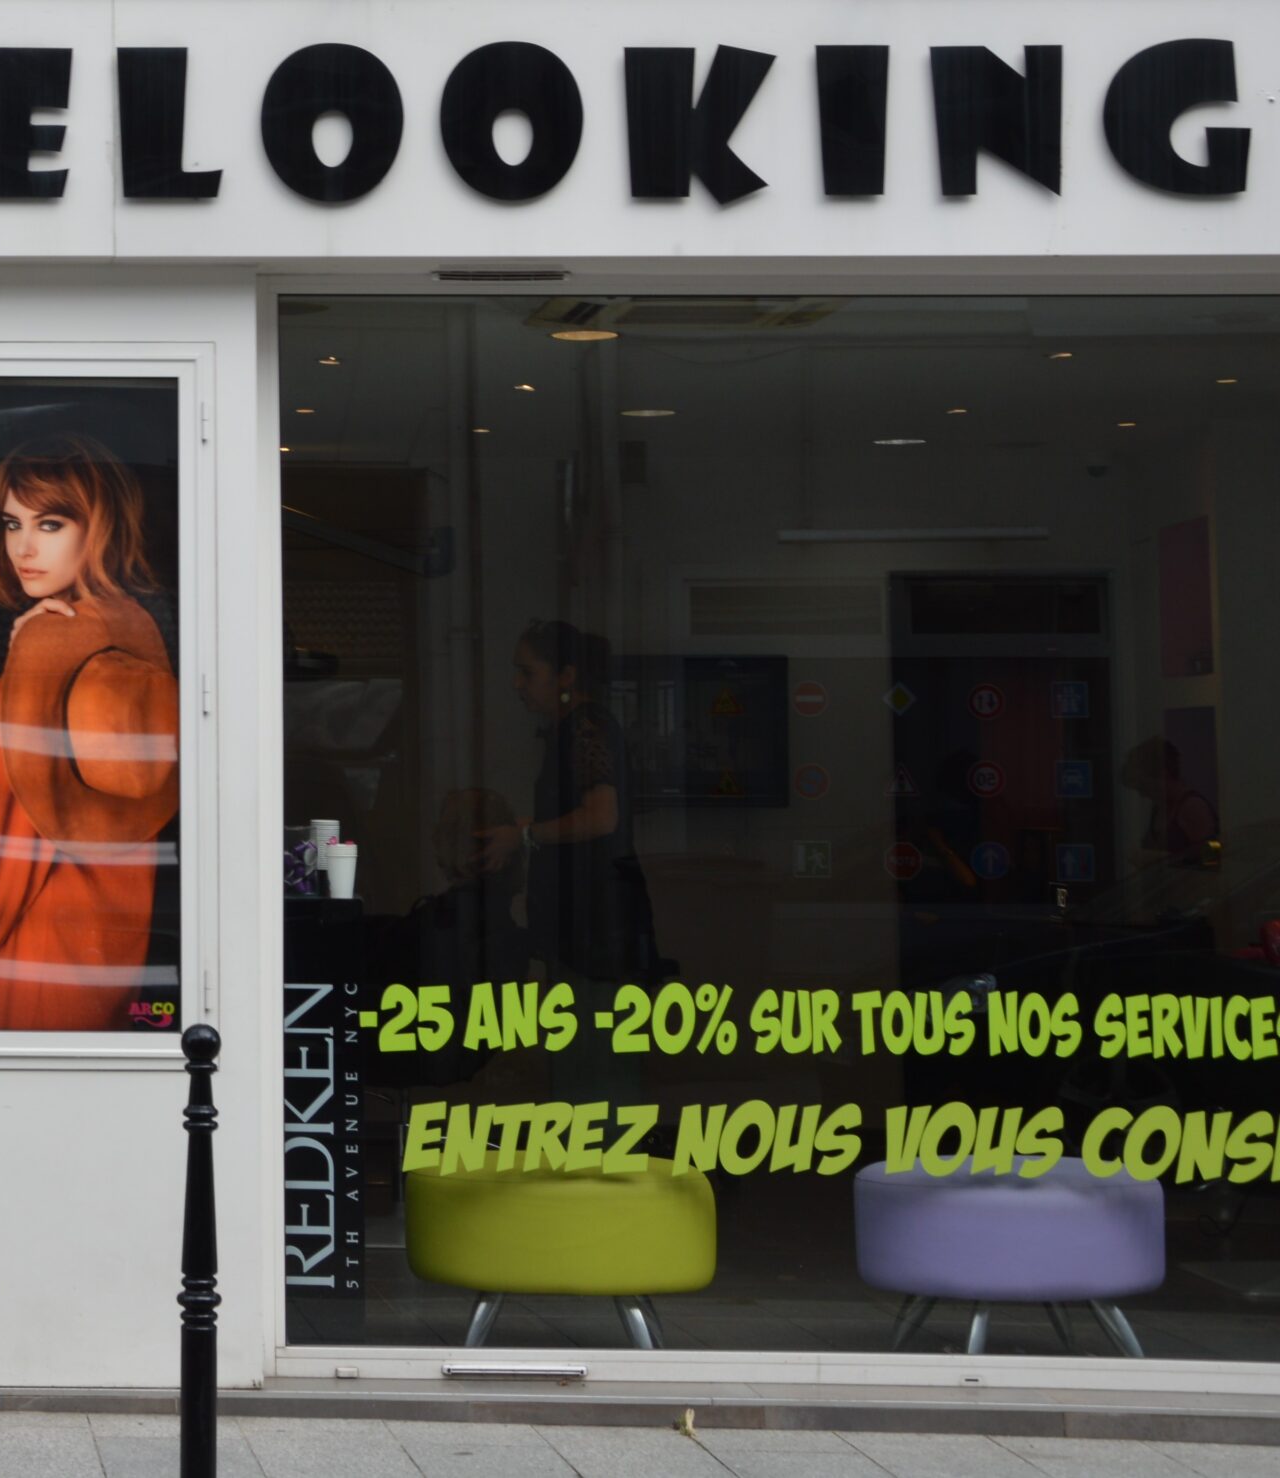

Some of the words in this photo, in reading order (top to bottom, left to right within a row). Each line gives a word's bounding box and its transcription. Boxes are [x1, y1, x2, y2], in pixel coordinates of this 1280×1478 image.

[128, 1001, 175, 1015] ARCO
[344, 983, 358, 1043] NYC
[360, 984, 455, 1052] -25
[463, 982, 577, 1052] ANS
[595, 983, 737, 1055] -20%
[750, 989, 842, 1055] SUR
[852, 990, 975, 1056] TOUS
[987, 991, 1082, 1057] NOS
[1094, 994, 1280, 1060] SERVICE
[284, 983, 335, 1288] REDKEN
[345, 1072, 359, 1202] AVENUE
[402, 1100, 659, 1176] ENTREZ
[672, 1099, 862, 1177] NOUS
[885, 1101, 1064, 1179] VOUS
[1082, 1105, 1280, 1184] CONS
[346, 1231, 359, 1288] 5TH
